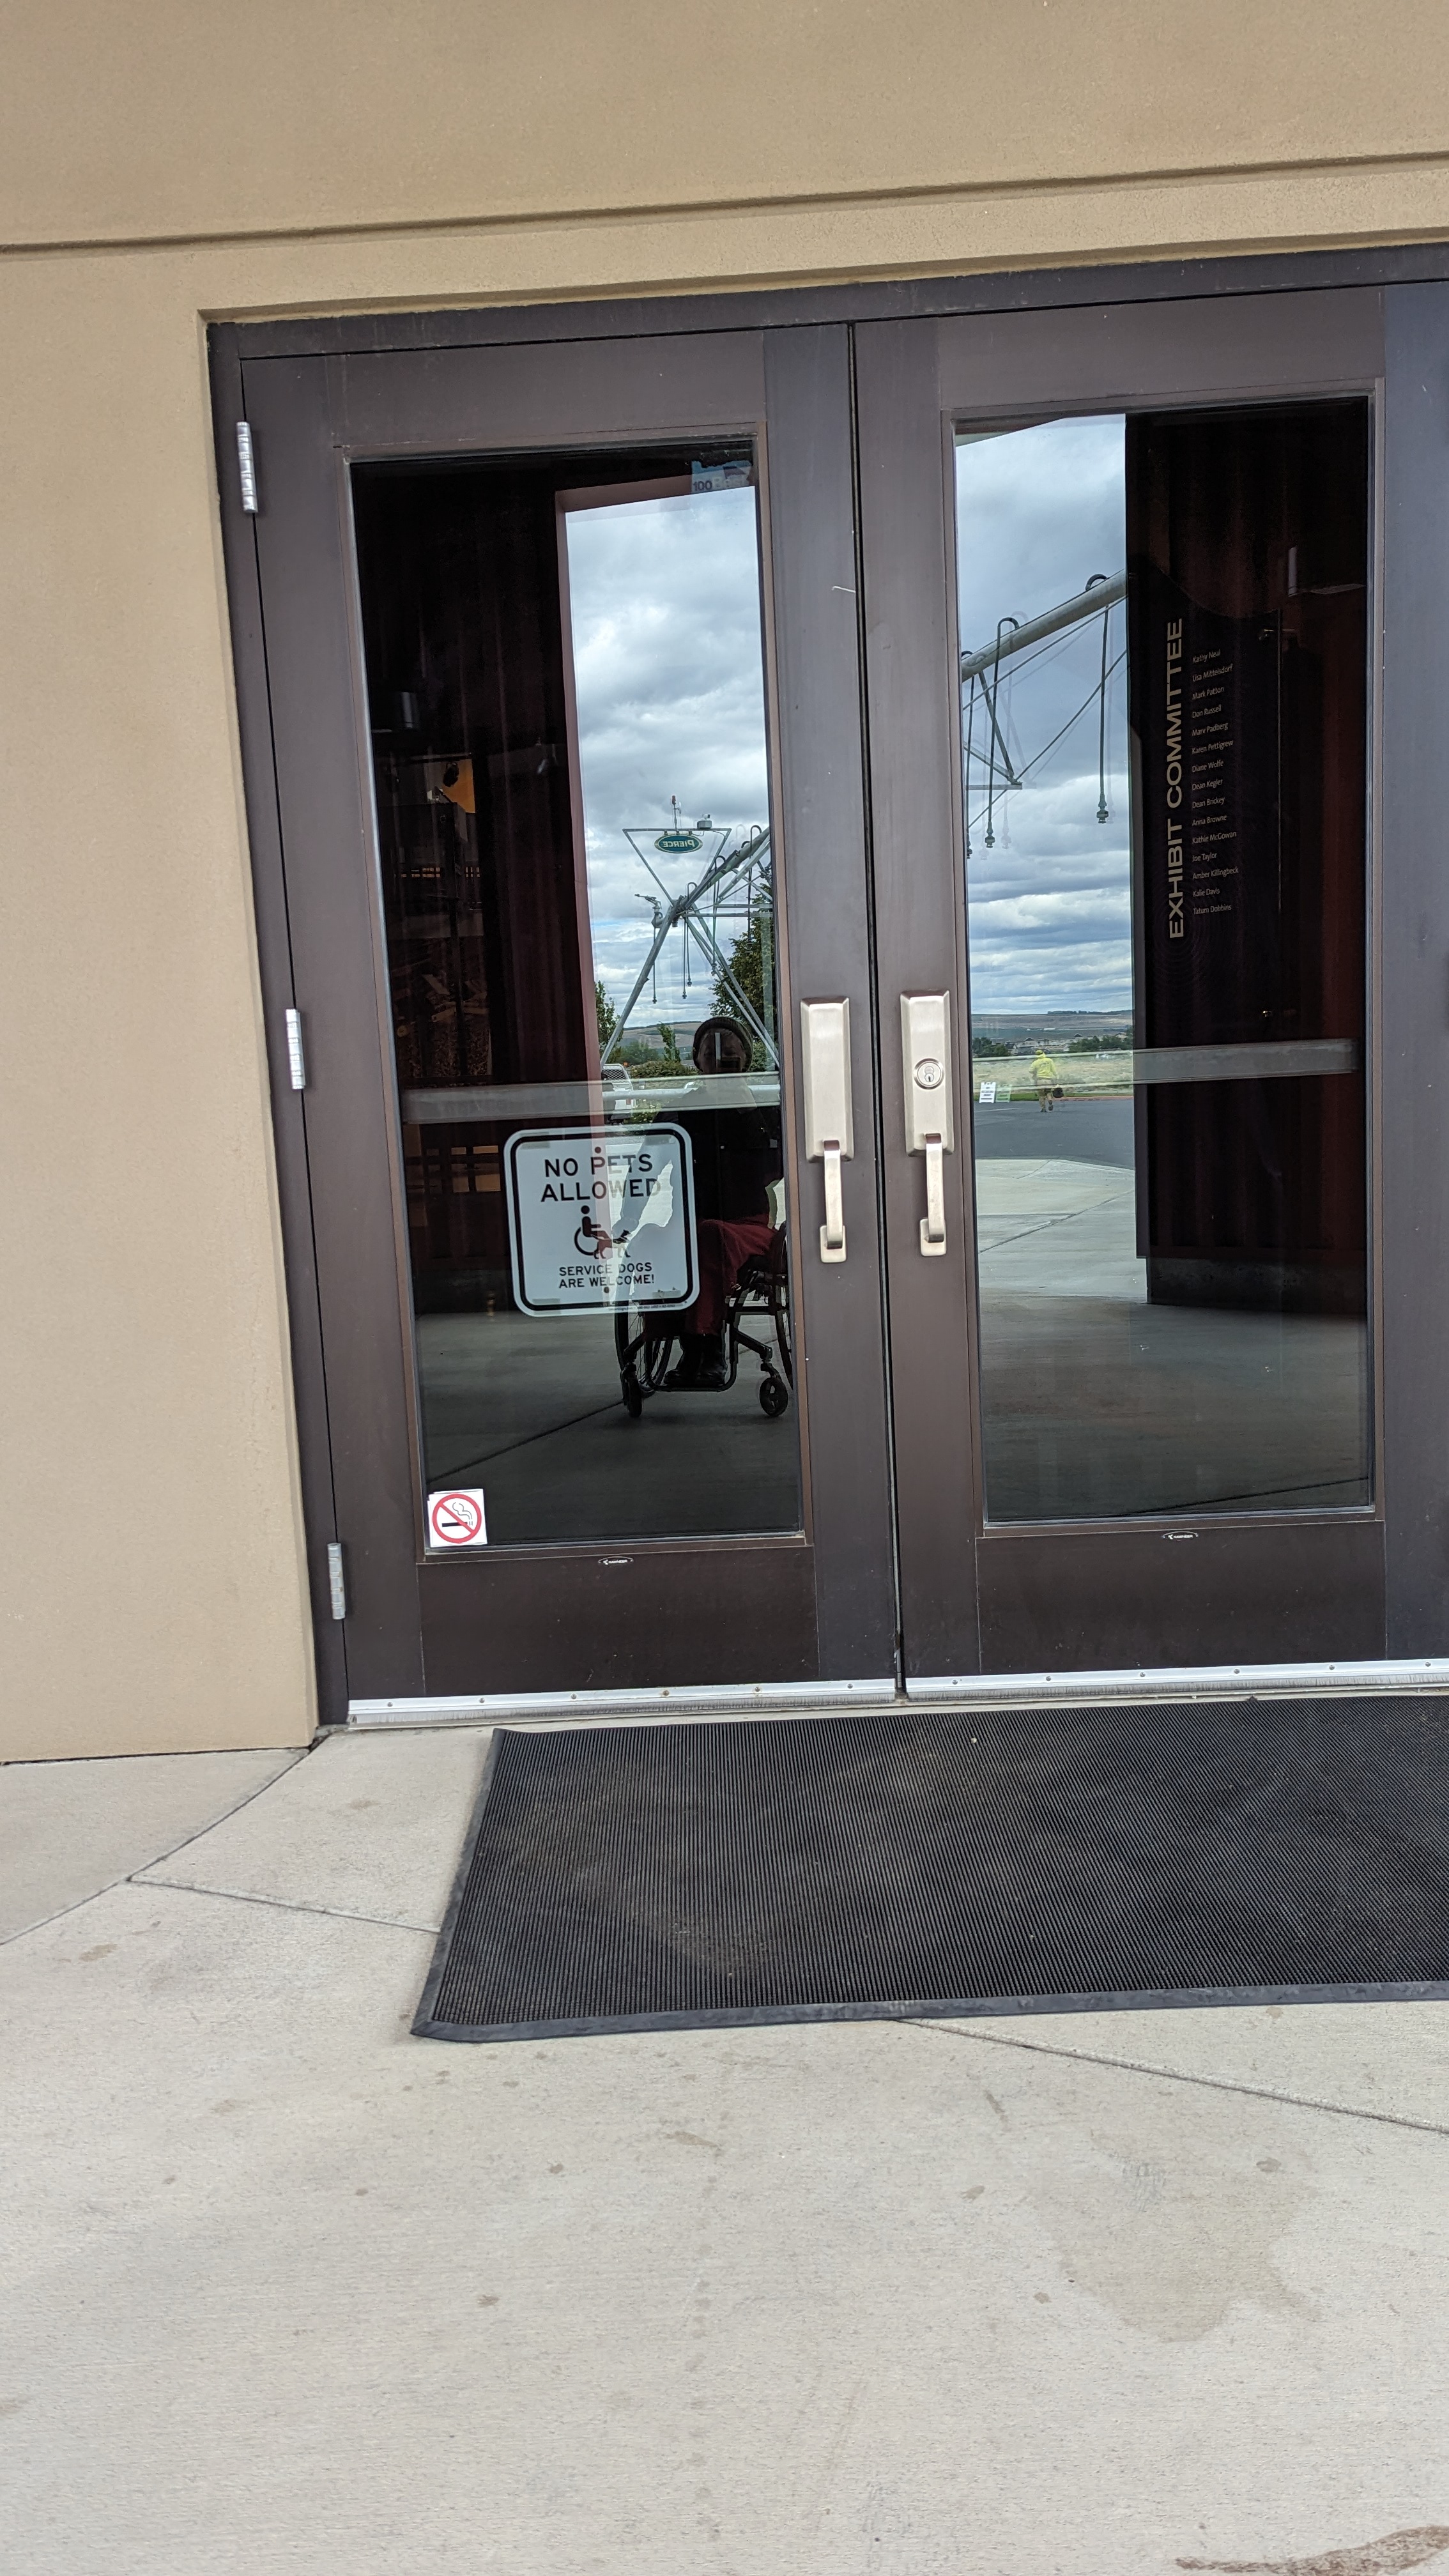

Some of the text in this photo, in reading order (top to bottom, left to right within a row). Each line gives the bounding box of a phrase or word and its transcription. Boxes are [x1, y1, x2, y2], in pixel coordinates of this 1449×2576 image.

[693, 480, 712, 491] 100
[1209, 649, 1221, 659] Neal
[1192, 687, 1224, 700] Mark Patton
[1192, 704, 1222, 719] Don Russell
[1208, 740, 1234, 751] Pettigrew
[1208, 760, 1224, 769] Wolfe
[1167, 618, 1183, 938] EXHIBIT COMMITTEE
[1192, 783, 1205, 791] Dean
[1206, 797, 1225, 806] Brickey
[1207, 815, 1227, 824] Browne
[1192, 831, 1237, 844] Kathie McGowan
[1202, 852, 1217, 862] Taylor
[1193, 871, 1209, 880] Amber
[1206, 887, 1220, 896] Davis
[1210, 904, 1232, 912] Dobbins
[544, 1154, 653, 1177] NO PETS
[540, 1178, 661, 1202] ALLOWED
[559, 1262, 652, 1276] SERVICE DOGS
[559, 1274, 655, 1289] ARE WELCOME!
